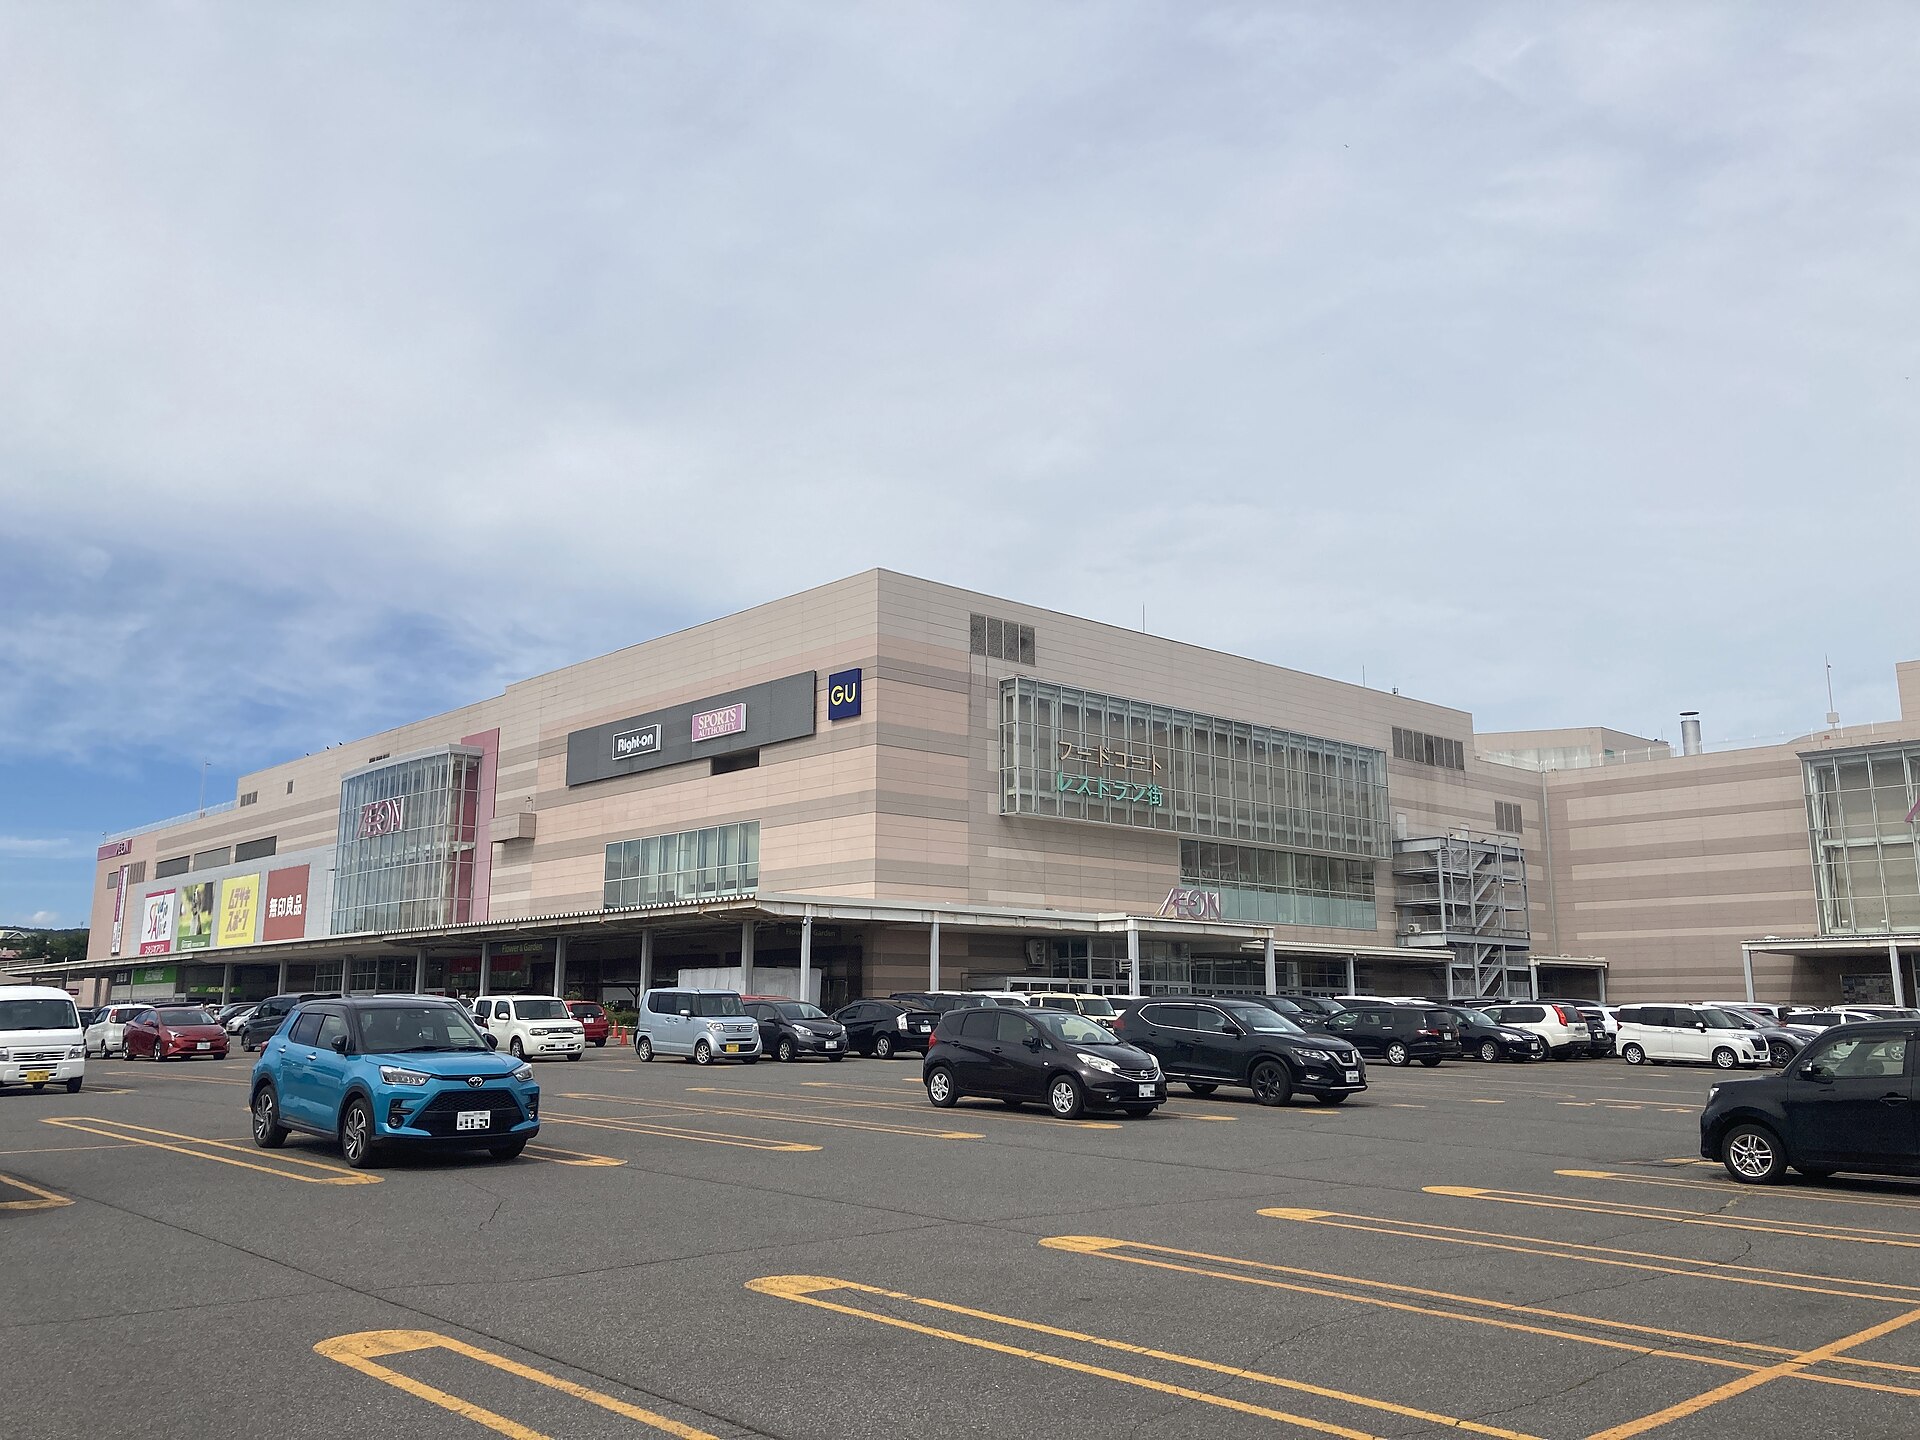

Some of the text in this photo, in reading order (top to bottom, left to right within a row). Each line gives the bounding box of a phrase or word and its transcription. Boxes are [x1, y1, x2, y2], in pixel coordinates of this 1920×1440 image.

[831, 683, 856, 706] GU
[698, 708, 737, 729] SPORTS
[698, 723, 737, 738] AUTHORITY
[617, 732, 654, 754] Right-on
[1058, 741, 1162, 776] フードコート
[1057, 772, 1163, 807] レストラン街
[356, 796, 405, 839] AEON
[228, 887, 251, 910] ムラサキ
[269, 894, 303, 918] 無印良品
[1156, 888, 1222, 922] AEON
[226, 909, 249, 932] スポーツ
[502, 944, 520, 952] Flower
[524, 942, 542, 951] Garden
